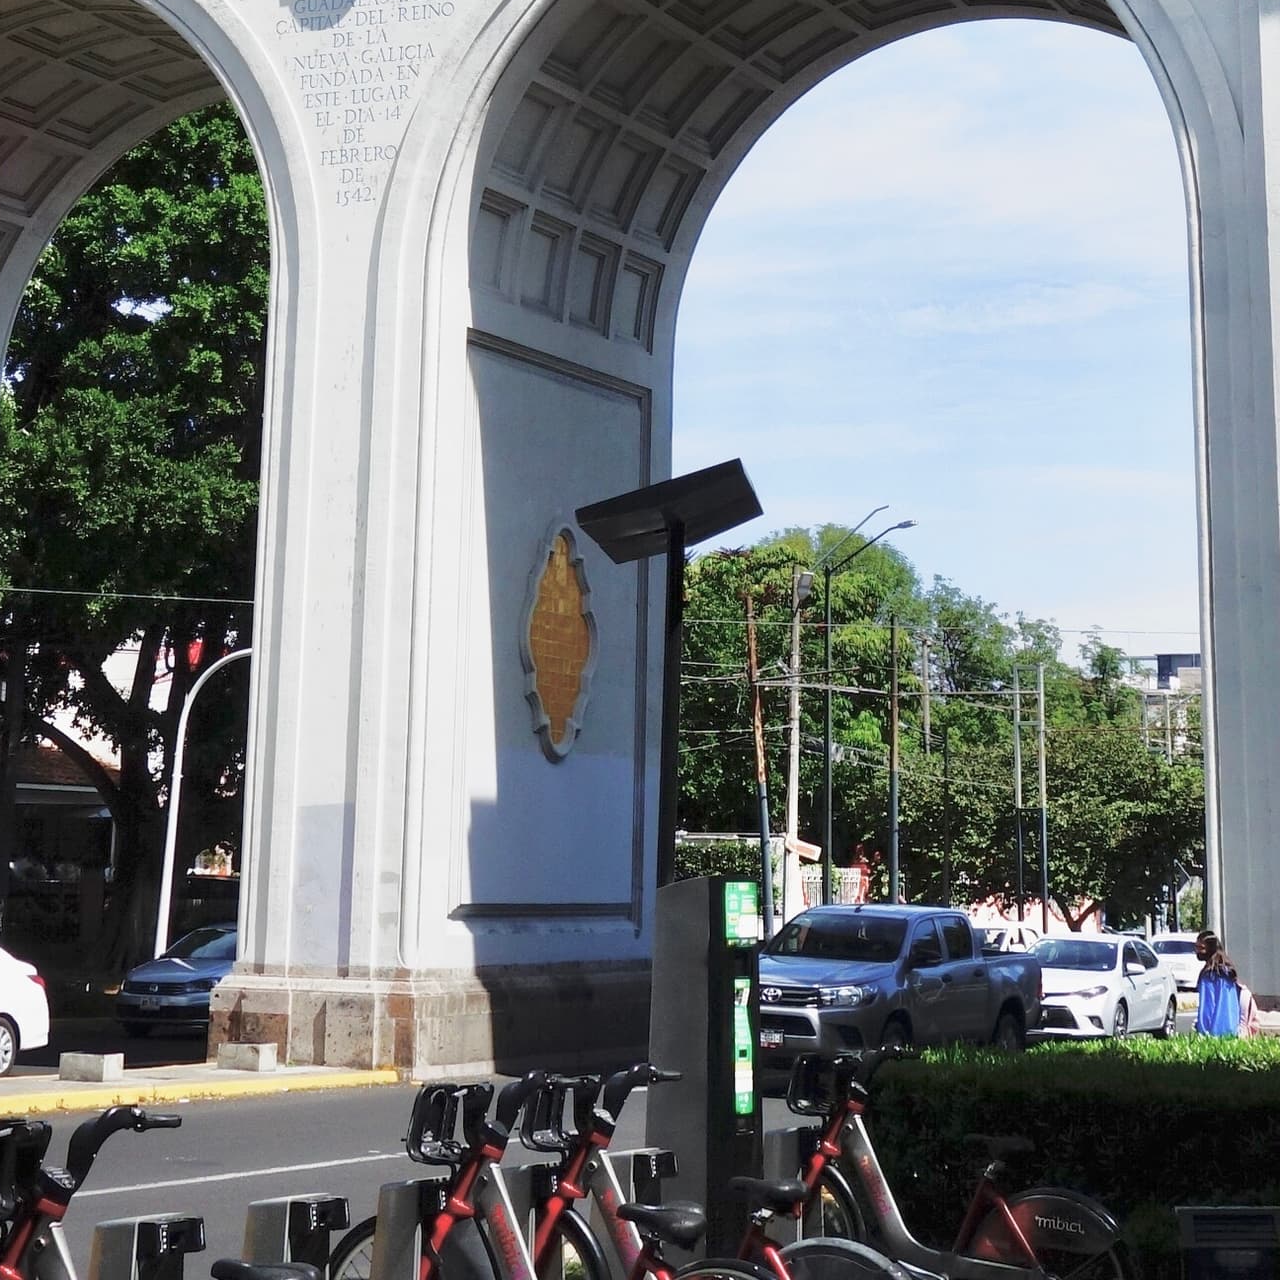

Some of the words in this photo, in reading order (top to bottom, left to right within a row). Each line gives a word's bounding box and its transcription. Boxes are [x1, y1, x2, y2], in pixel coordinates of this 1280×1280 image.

[275, 12, 346, 36] CAPITAL
[355, 9, 388, 27] DEL
[398, 1, 456, 23] REINO
[332, 31, 355, 49] DE
[366, 27, 388, 45] LA
[294, 51, 350, 71] NUEVA
[361, 41, 436, 65] GALICIA
[300, 66, 385, 90] FUNDADA
[397, 63, 421, 81] EN
[304, 91, 342, 109] ESTE
[351, 84, 412, 105] LUGAR
[316, 111, 335, 128] EL
[344, 107, 376, 125] DIA
[385, 105, 402, 121] 14
[343, 127, 366, 144] DE
[320, 144, 399, 166] FEBRERO
[341, 167, 364, 184] DE
[1034, 1214, 1085, 1235] mibici
